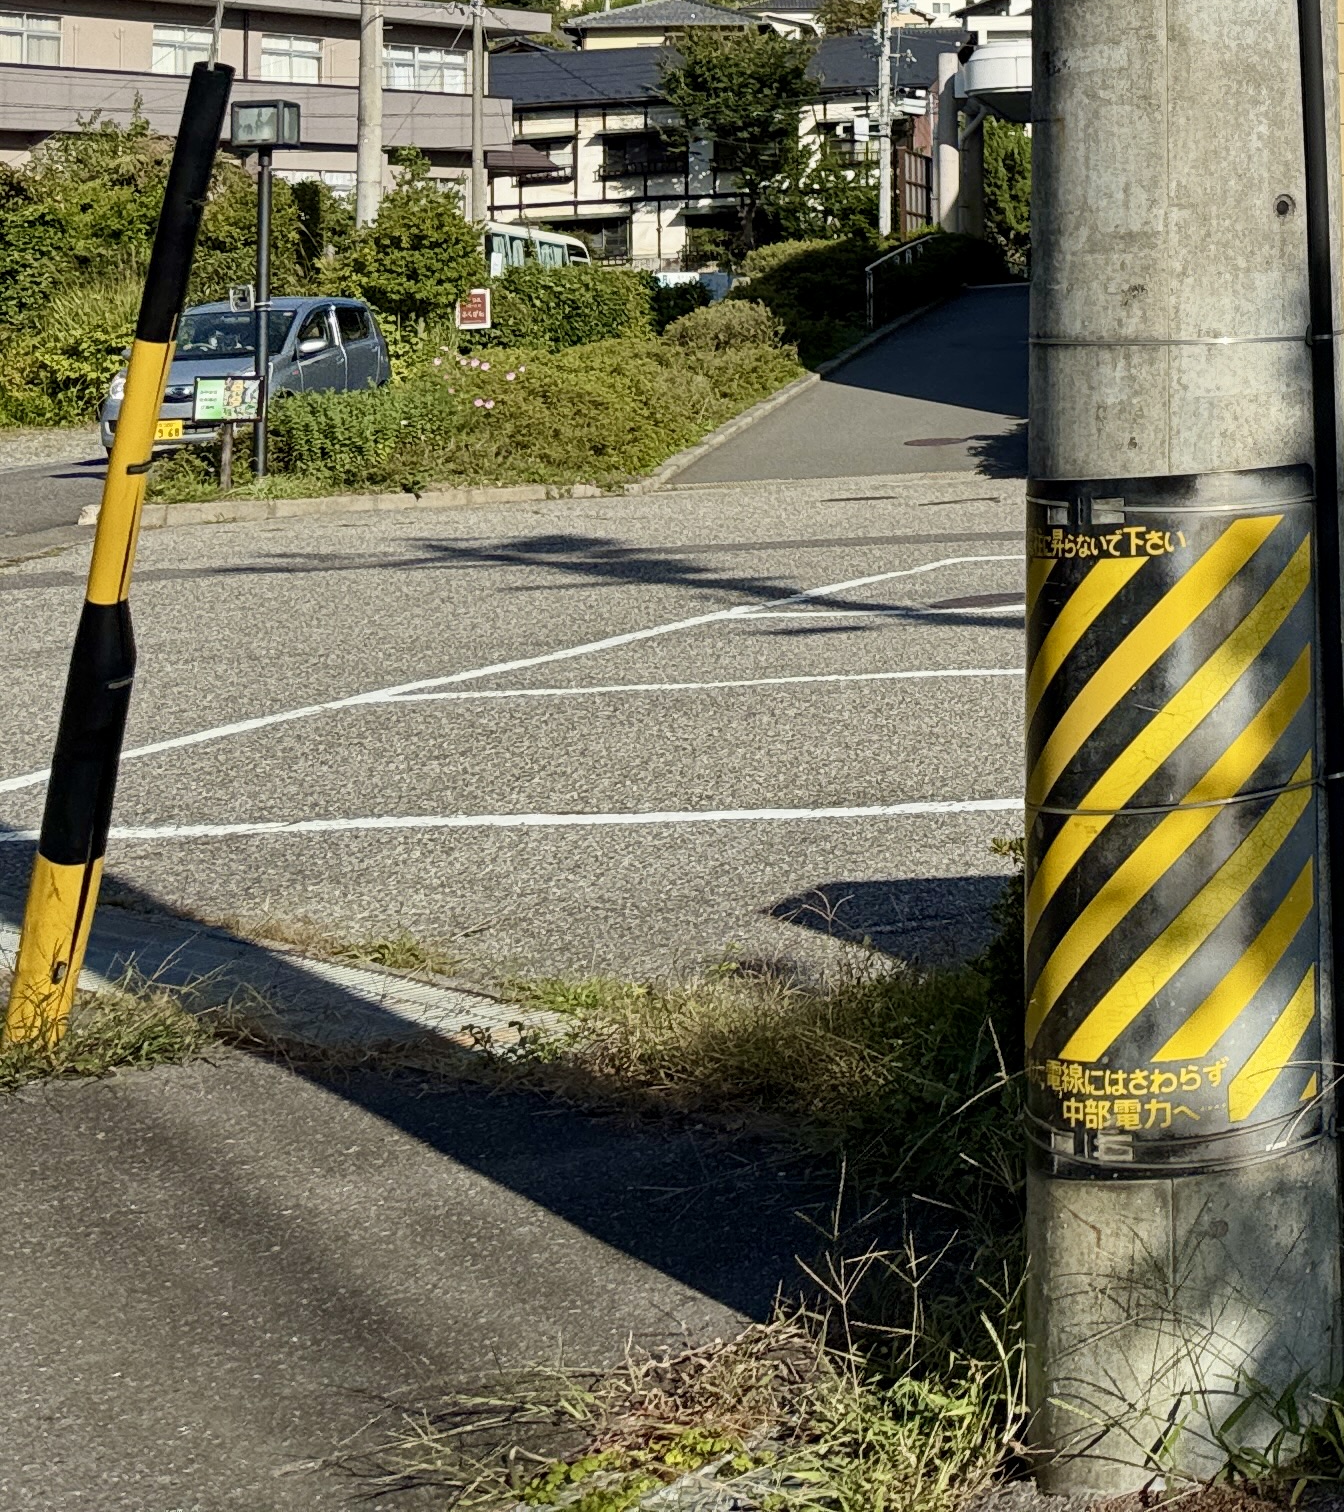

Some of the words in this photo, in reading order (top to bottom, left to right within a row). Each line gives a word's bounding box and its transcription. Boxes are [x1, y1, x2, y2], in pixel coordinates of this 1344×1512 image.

[1062, 1098, 1201, 1131] 中部電力へ
